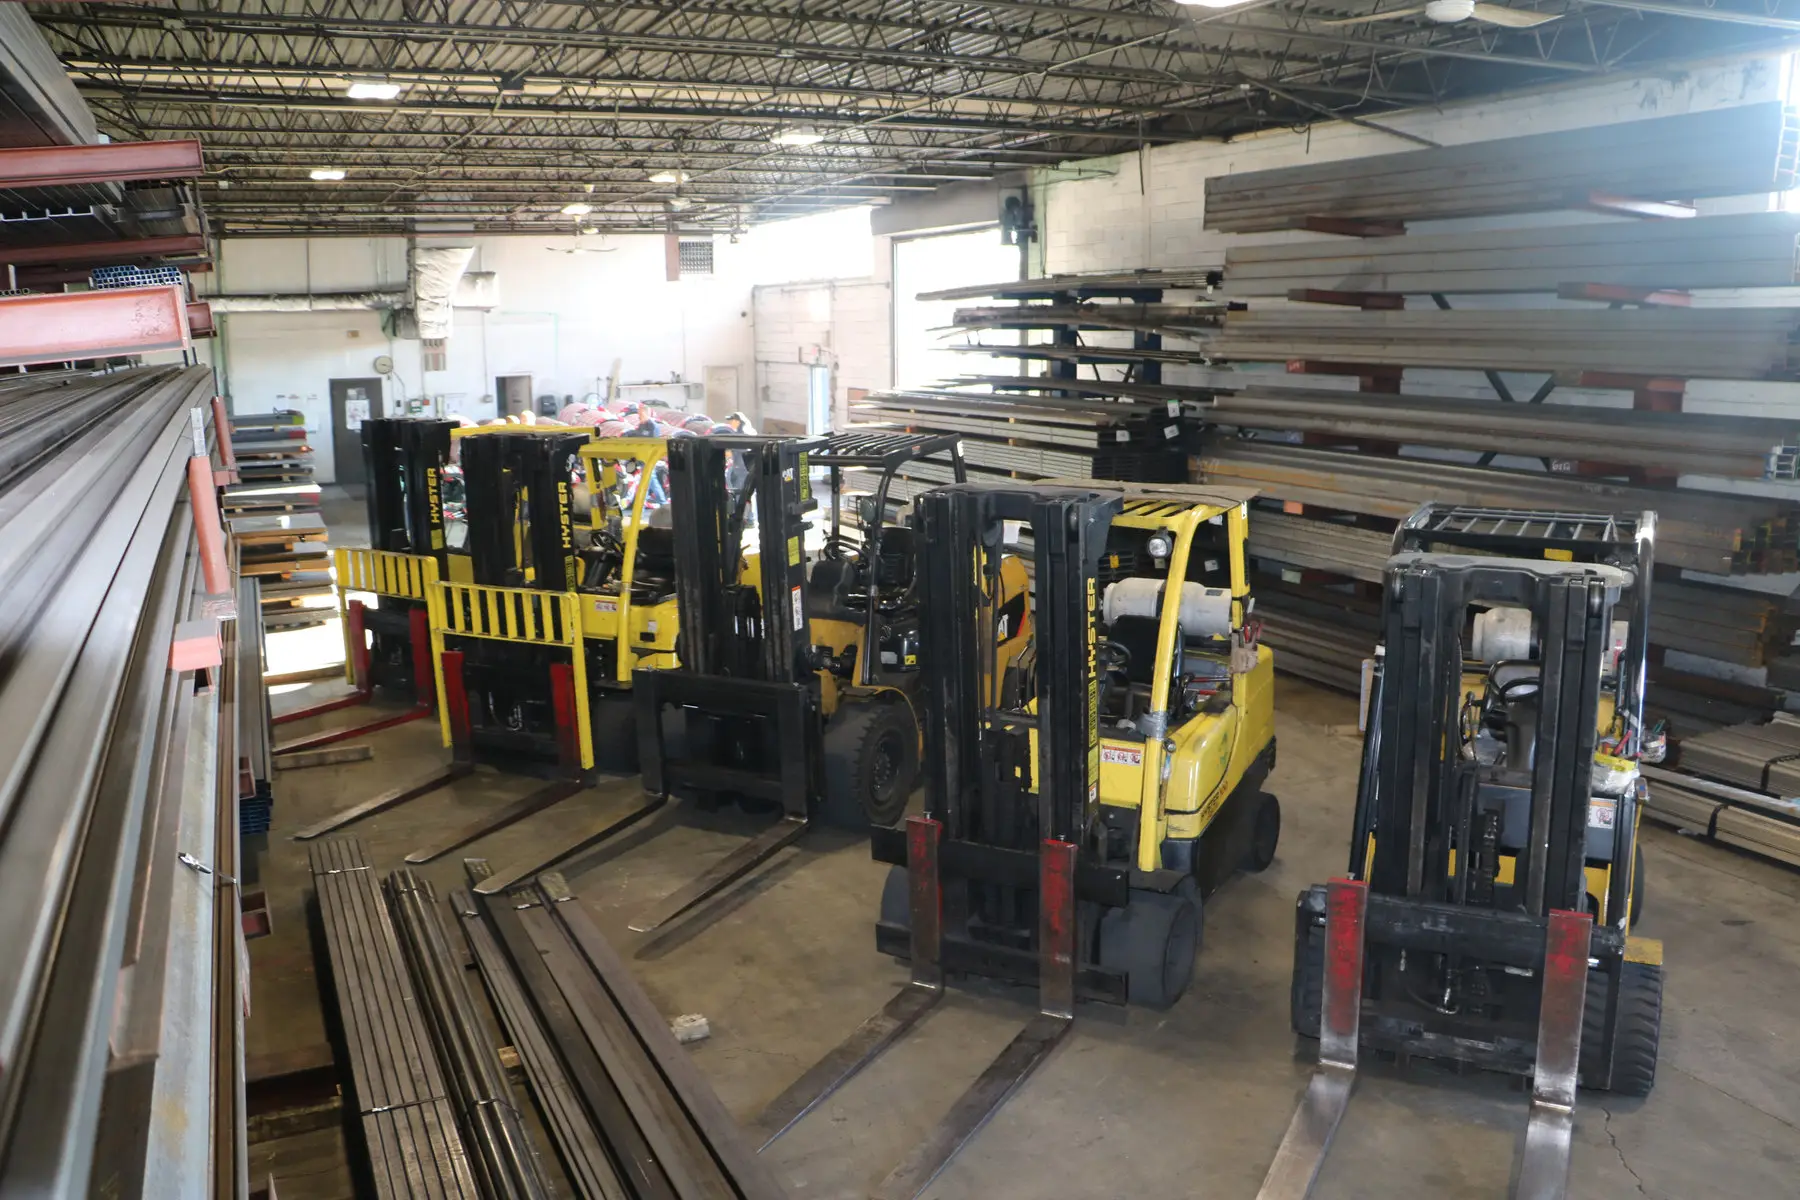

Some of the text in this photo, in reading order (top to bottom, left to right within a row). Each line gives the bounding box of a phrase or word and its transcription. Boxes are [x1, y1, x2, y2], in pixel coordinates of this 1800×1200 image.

[427, 467, 440, 523] HYSTER
[557, 482, 571, 548] HYSTER
[1087, 578, 1097, 678] HYSTER
